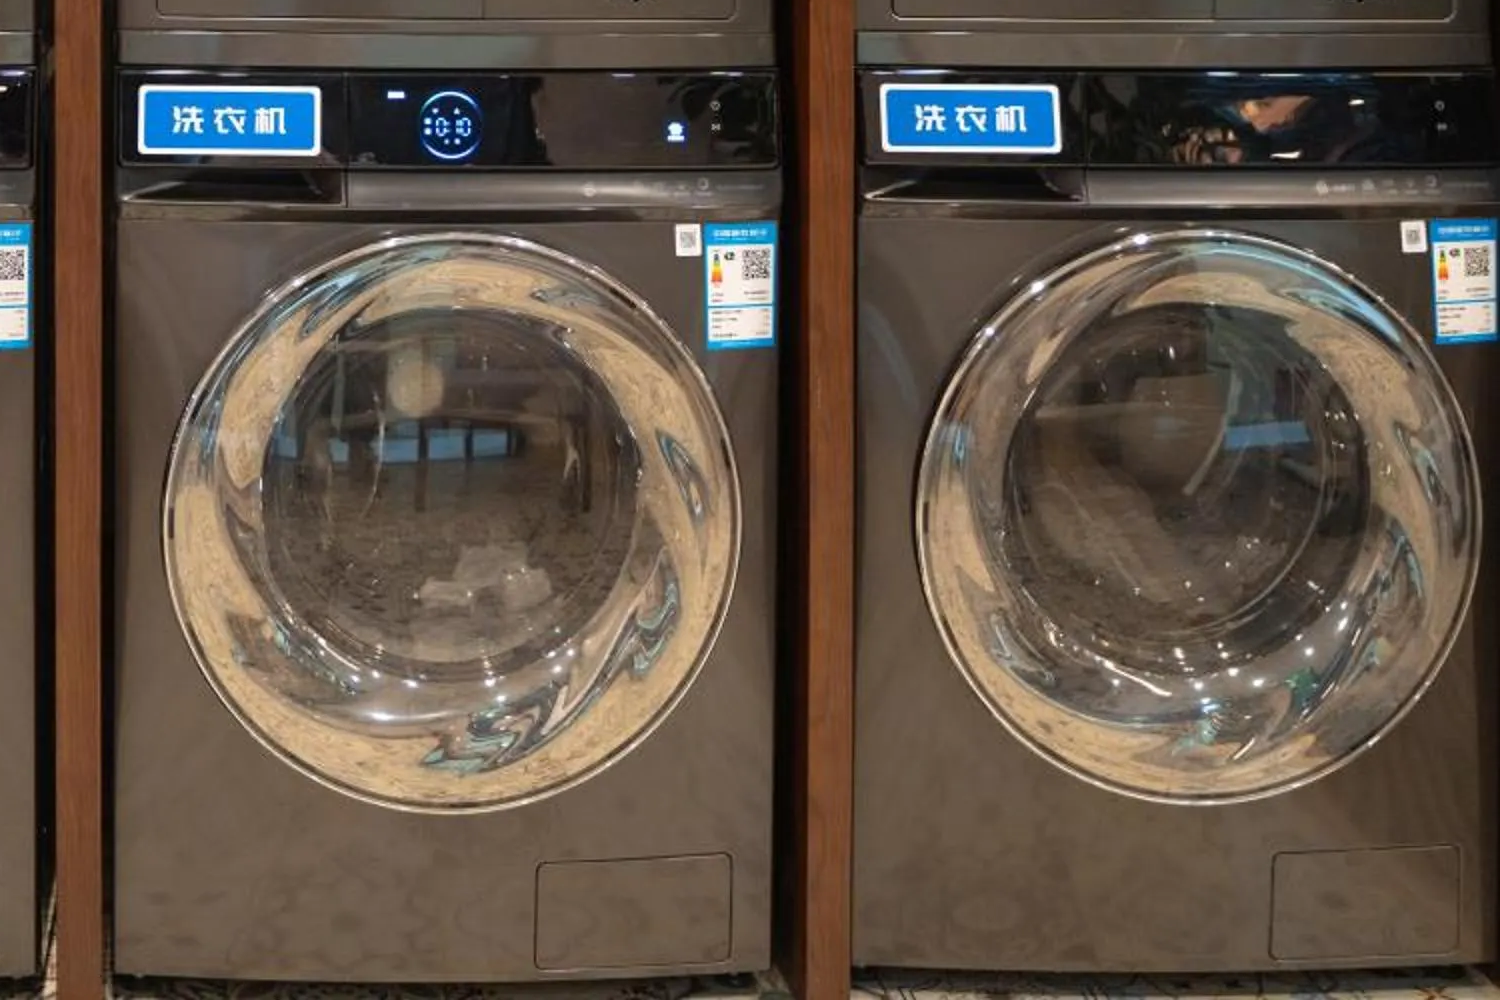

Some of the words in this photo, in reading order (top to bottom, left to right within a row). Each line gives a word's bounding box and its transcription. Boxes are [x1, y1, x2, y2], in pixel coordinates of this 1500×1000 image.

[172, 106, 287, 135] 洗衣机
[914, 104, 1027, 133] 洗衣机
